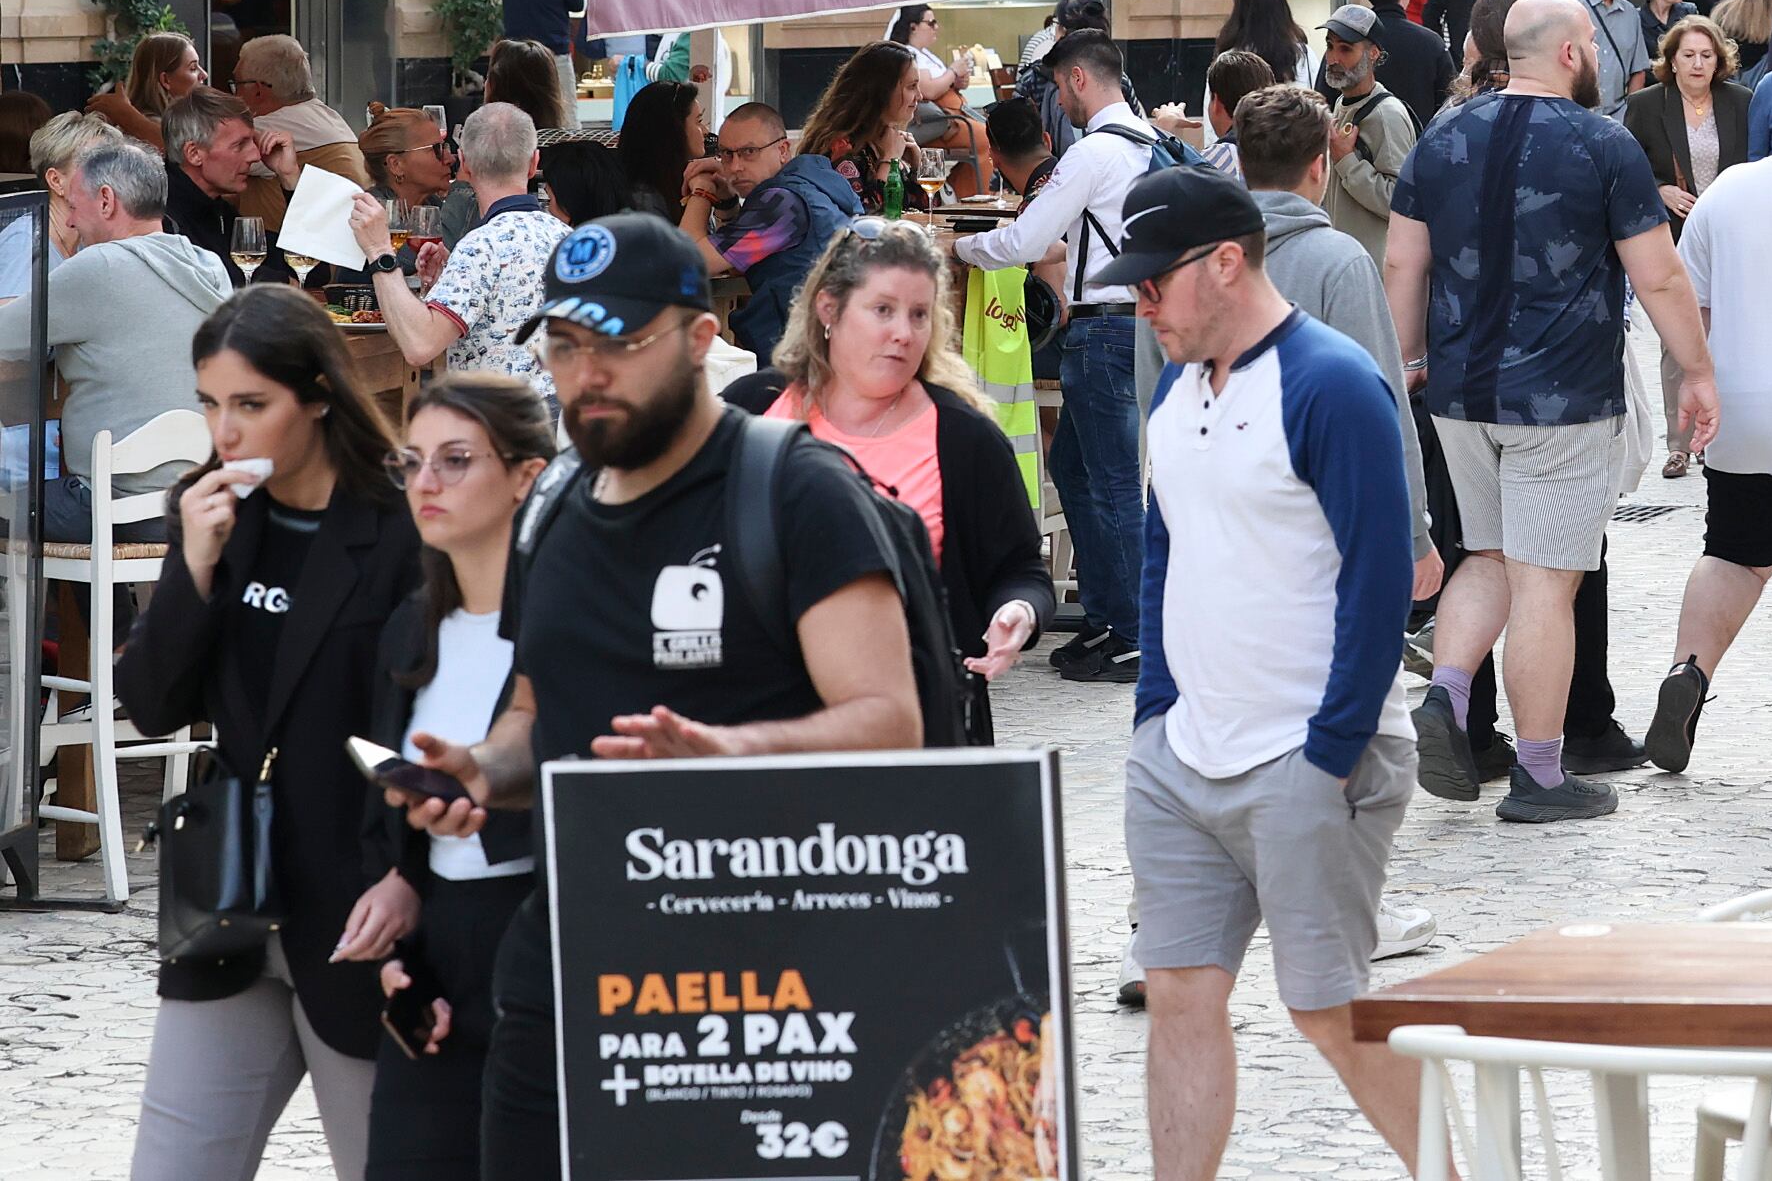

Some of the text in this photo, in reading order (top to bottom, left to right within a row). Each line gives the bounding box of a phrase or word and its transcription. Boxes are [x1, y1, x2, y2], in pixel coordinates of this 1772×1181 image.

[625, 822, 970, 886] Sarandonga
[659, 890, 774, 914] Cervecería
[791, 889, 872, 911] Arroces
[887, 887, 942, 909] Vinos
[597, 969, 813, 1015] PAELLA
[599, 1012, 858, 1059] PARA 2 PAX
[643, 1060, 853, 1086] BOTELLA DE VINO
[755, 1120, 849, 1160] 32€
